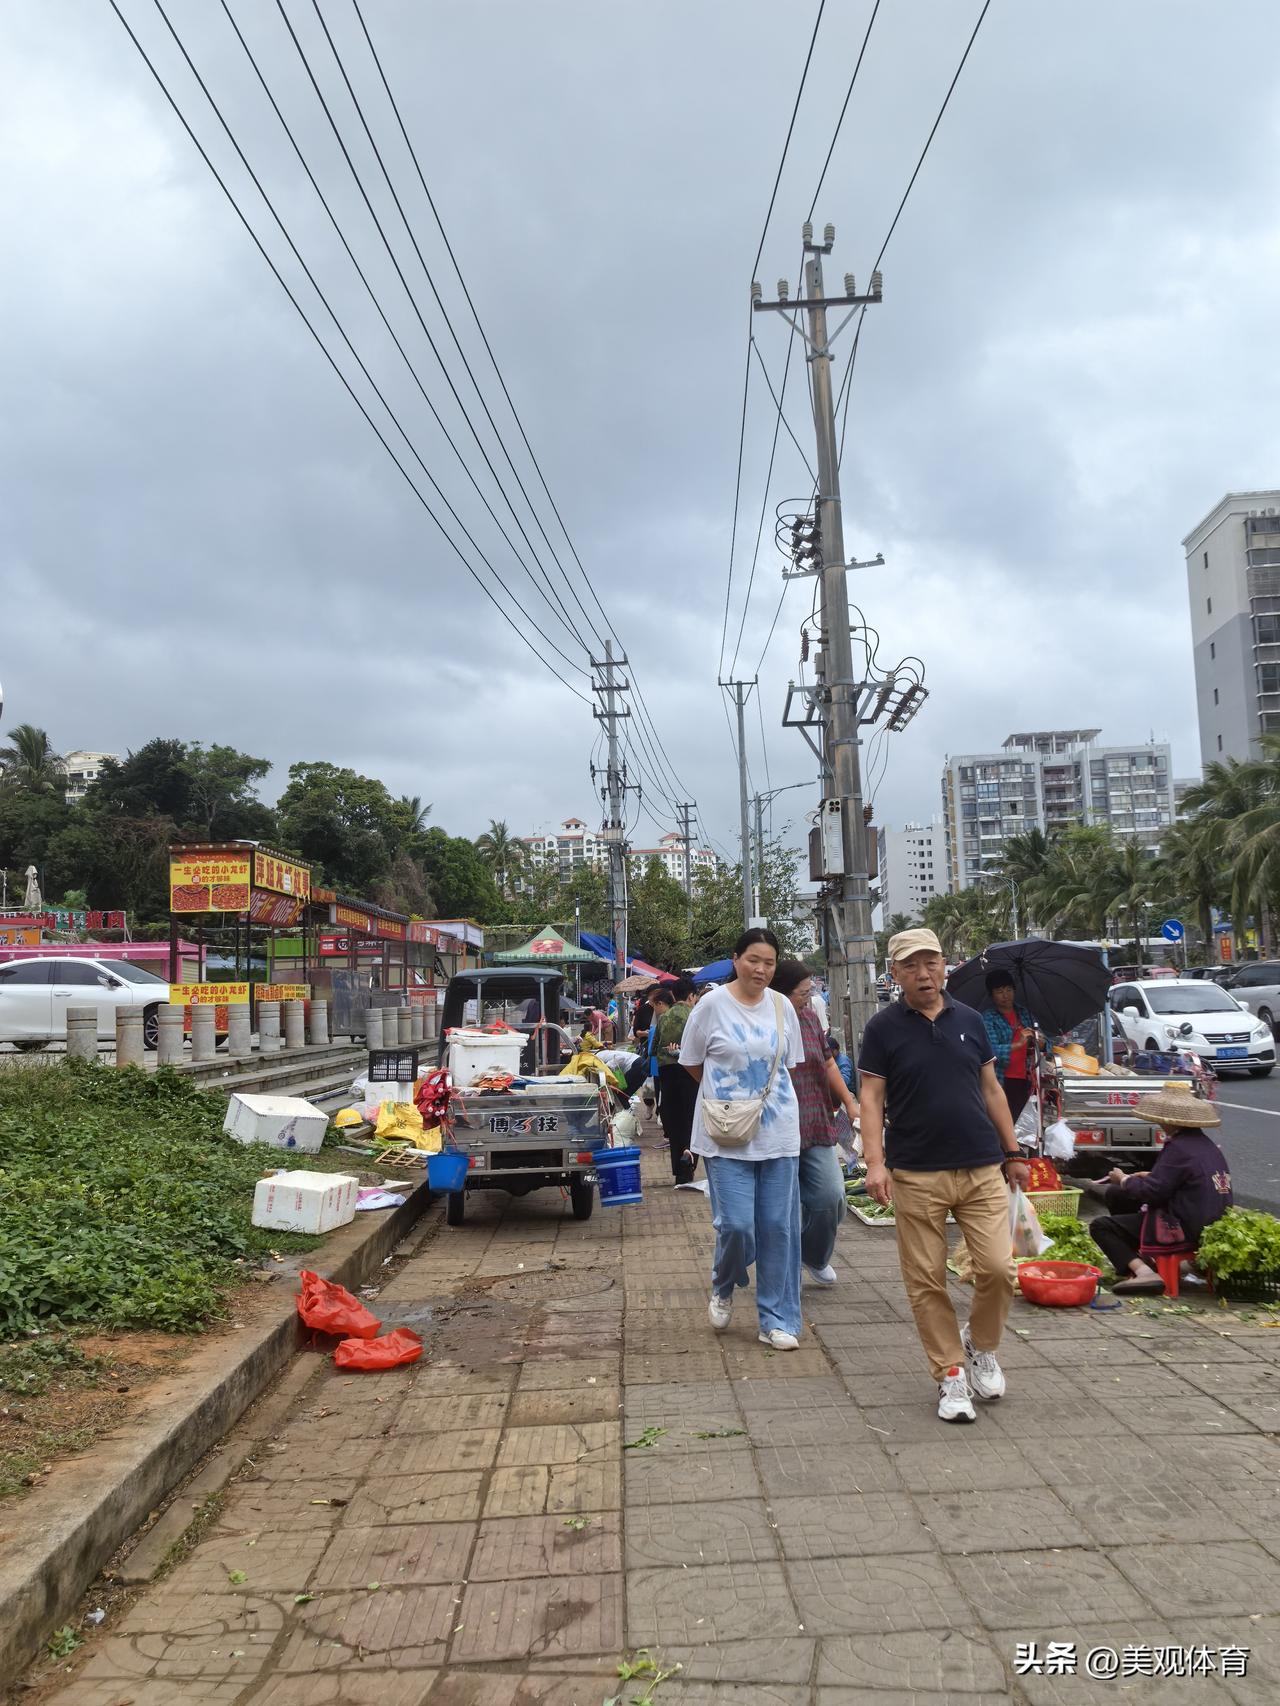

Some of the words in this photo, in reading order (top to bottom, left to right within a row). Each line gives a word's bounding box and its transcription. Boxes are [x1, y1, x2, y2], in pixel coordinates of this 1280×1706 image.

[173, 864, 248, 875] 一生必吃的小龙虾
[172, 985, 247, 996] 一生必吃的小龙虾
